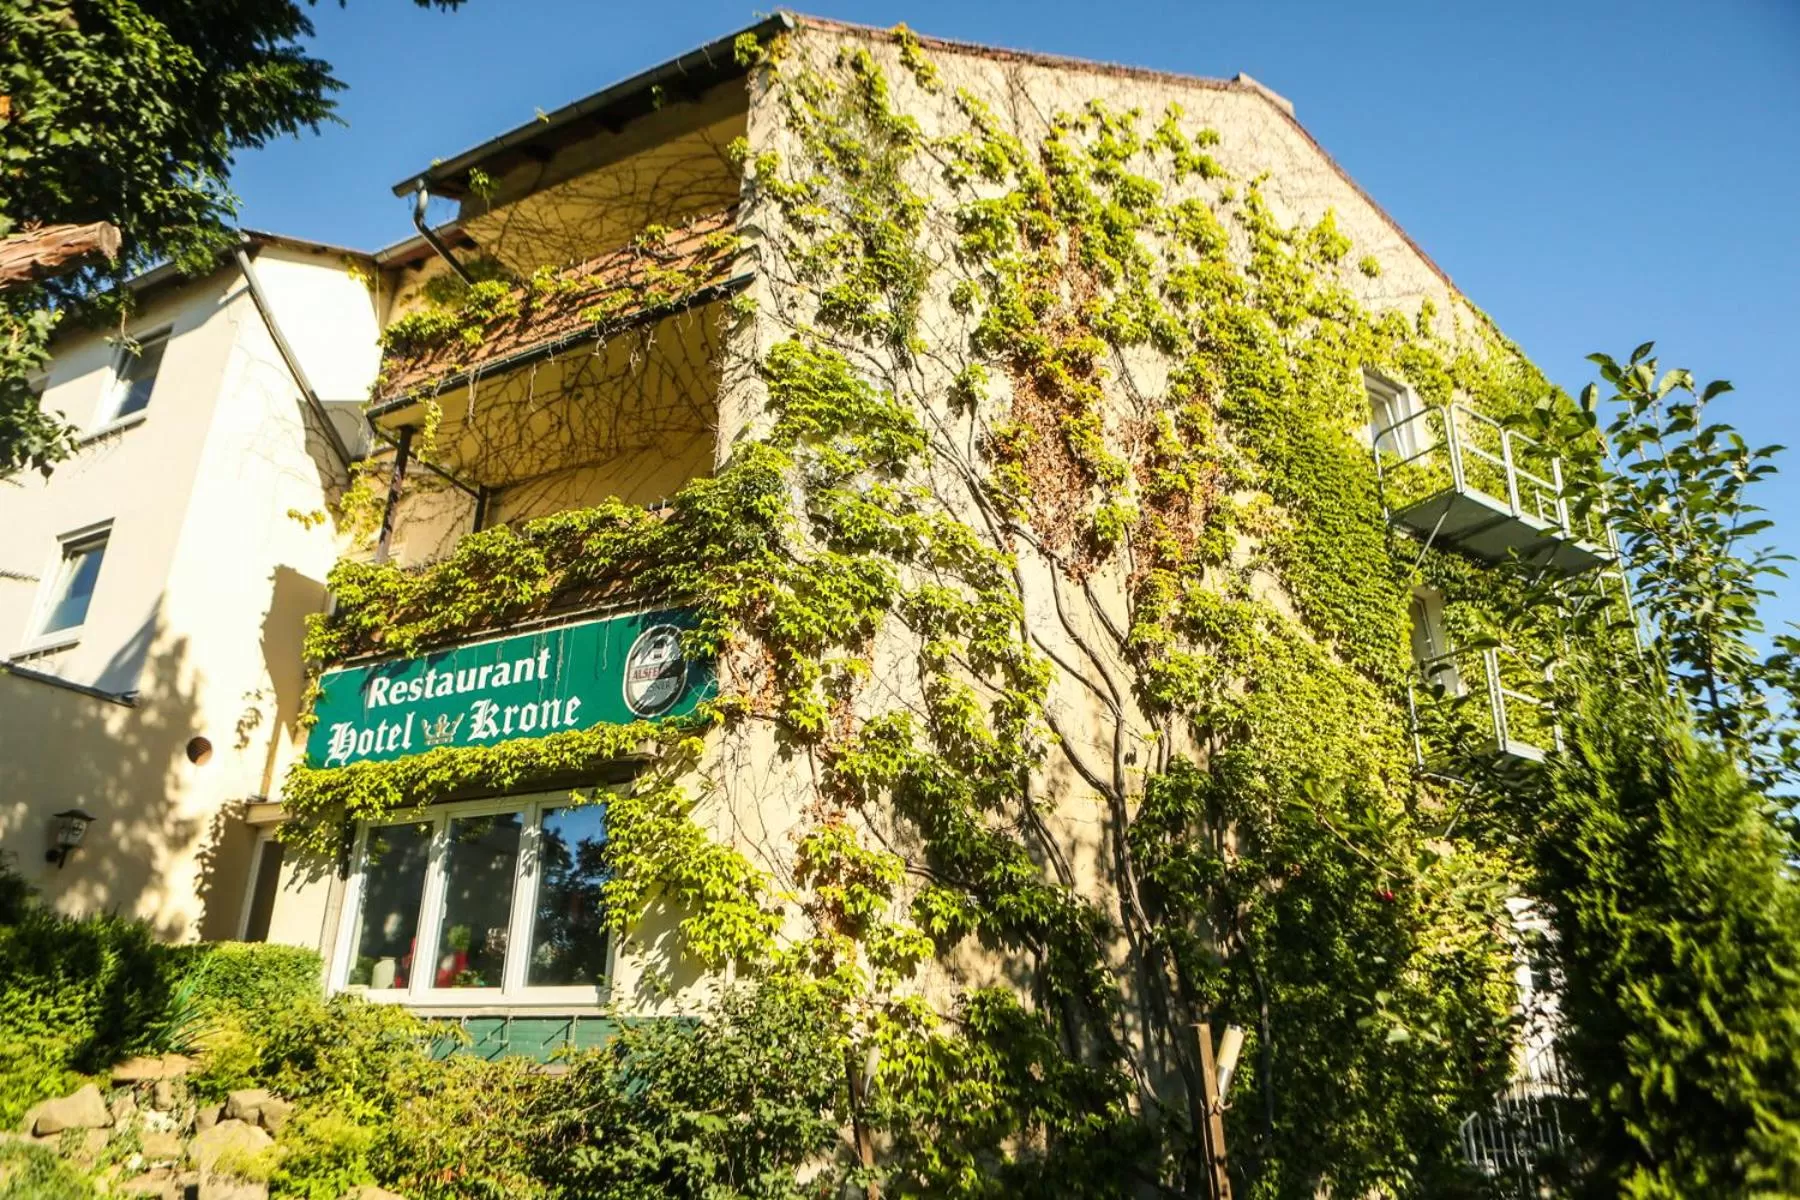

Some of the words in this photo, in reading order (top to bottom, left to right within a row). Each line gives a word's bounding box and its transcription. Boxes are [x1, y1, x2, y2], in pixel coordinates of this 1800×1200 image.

[367, 648, 551, 709] Restaurant
[324, 711, 416, 768] Hotel
[467, 696, 581, 742] Krone
